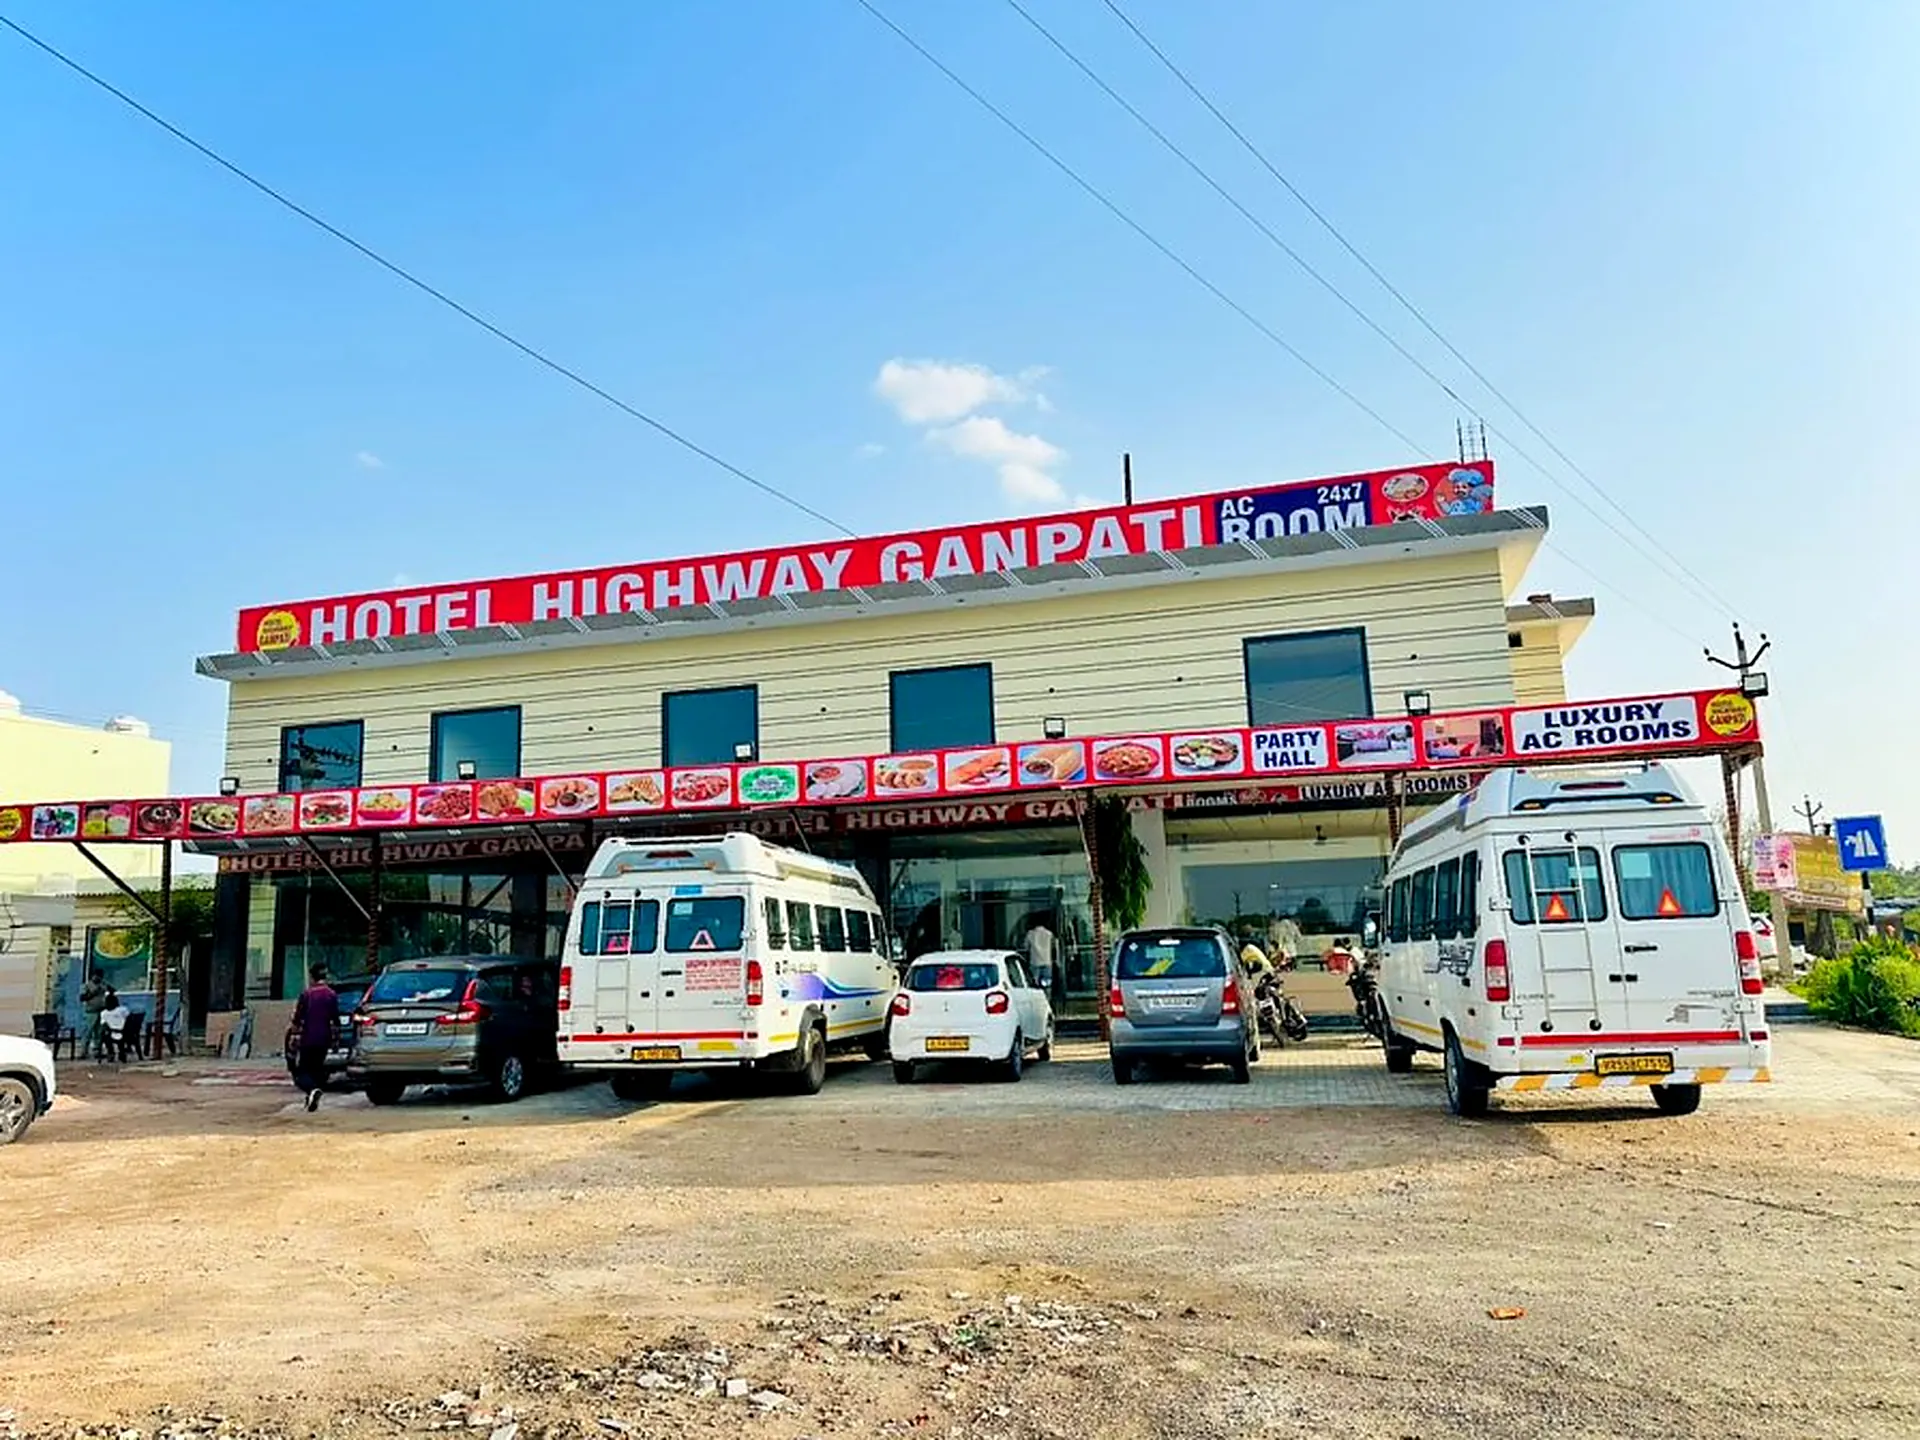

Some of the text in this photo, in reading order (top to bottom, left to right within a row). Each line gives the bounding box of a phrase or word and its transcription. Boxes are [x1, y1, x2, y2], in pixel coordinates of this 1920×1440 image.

[1317, 481, 1363, 504] 24x7
[1220, 496, 1254, 518] AC
[1222, 501, 1366, 544] ROOM
[310, 505, 1200, 646] HOTEL HIGHWAY GANPATI
[1544, 702, 1664, 729] LUXURY
[1255, 731, 1320, 749] PARTY
[1522, 720, 1691, 750] AC ROOMS
[1264, 750, 1316, 768] HALL
[1301, 781, 1367, 799] LUXURY
[846, 804, 1010, 829] HIGHWAY
